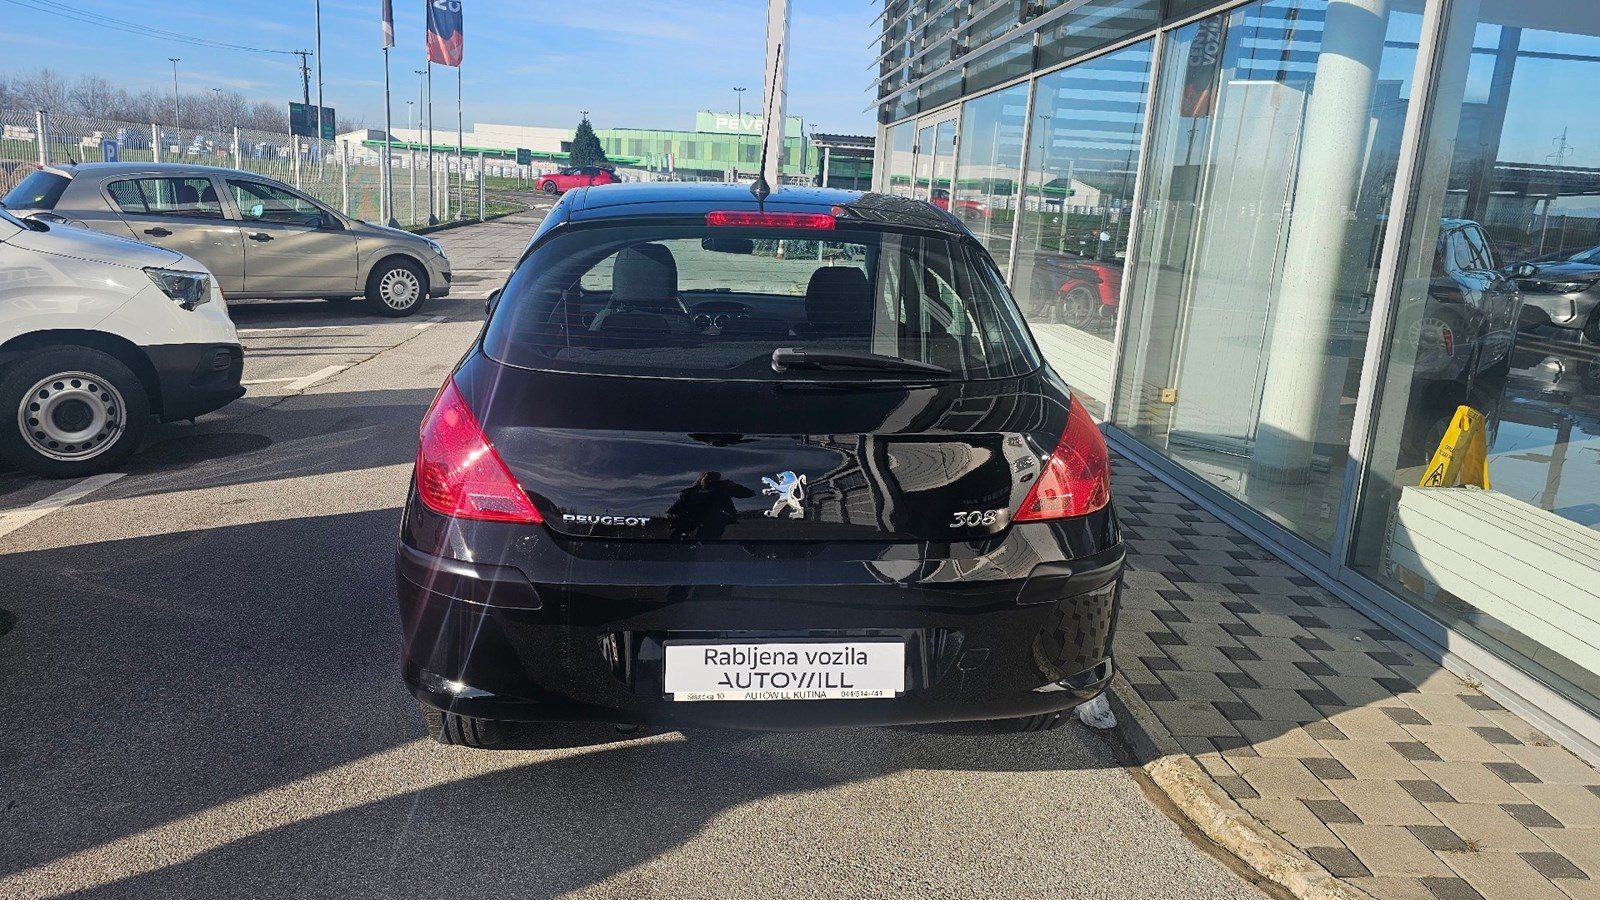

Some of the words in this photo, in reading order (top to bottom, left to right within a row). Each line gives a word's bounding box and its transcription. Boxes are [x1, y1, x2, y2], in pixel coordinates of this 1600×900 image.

[715, 117, 763, 131] PEVE
[106, 144, 115, 163] P
[562, 513, 650, 526] PEUGEOT
[949, 509, 997, 528] 308
[704, 646, 797, 670] Rabljena
[804, 647, 868, 666] vozila
[717, 672, 854, 689] AUTOWILL
[794, 691, 827, 699] KUTINA
